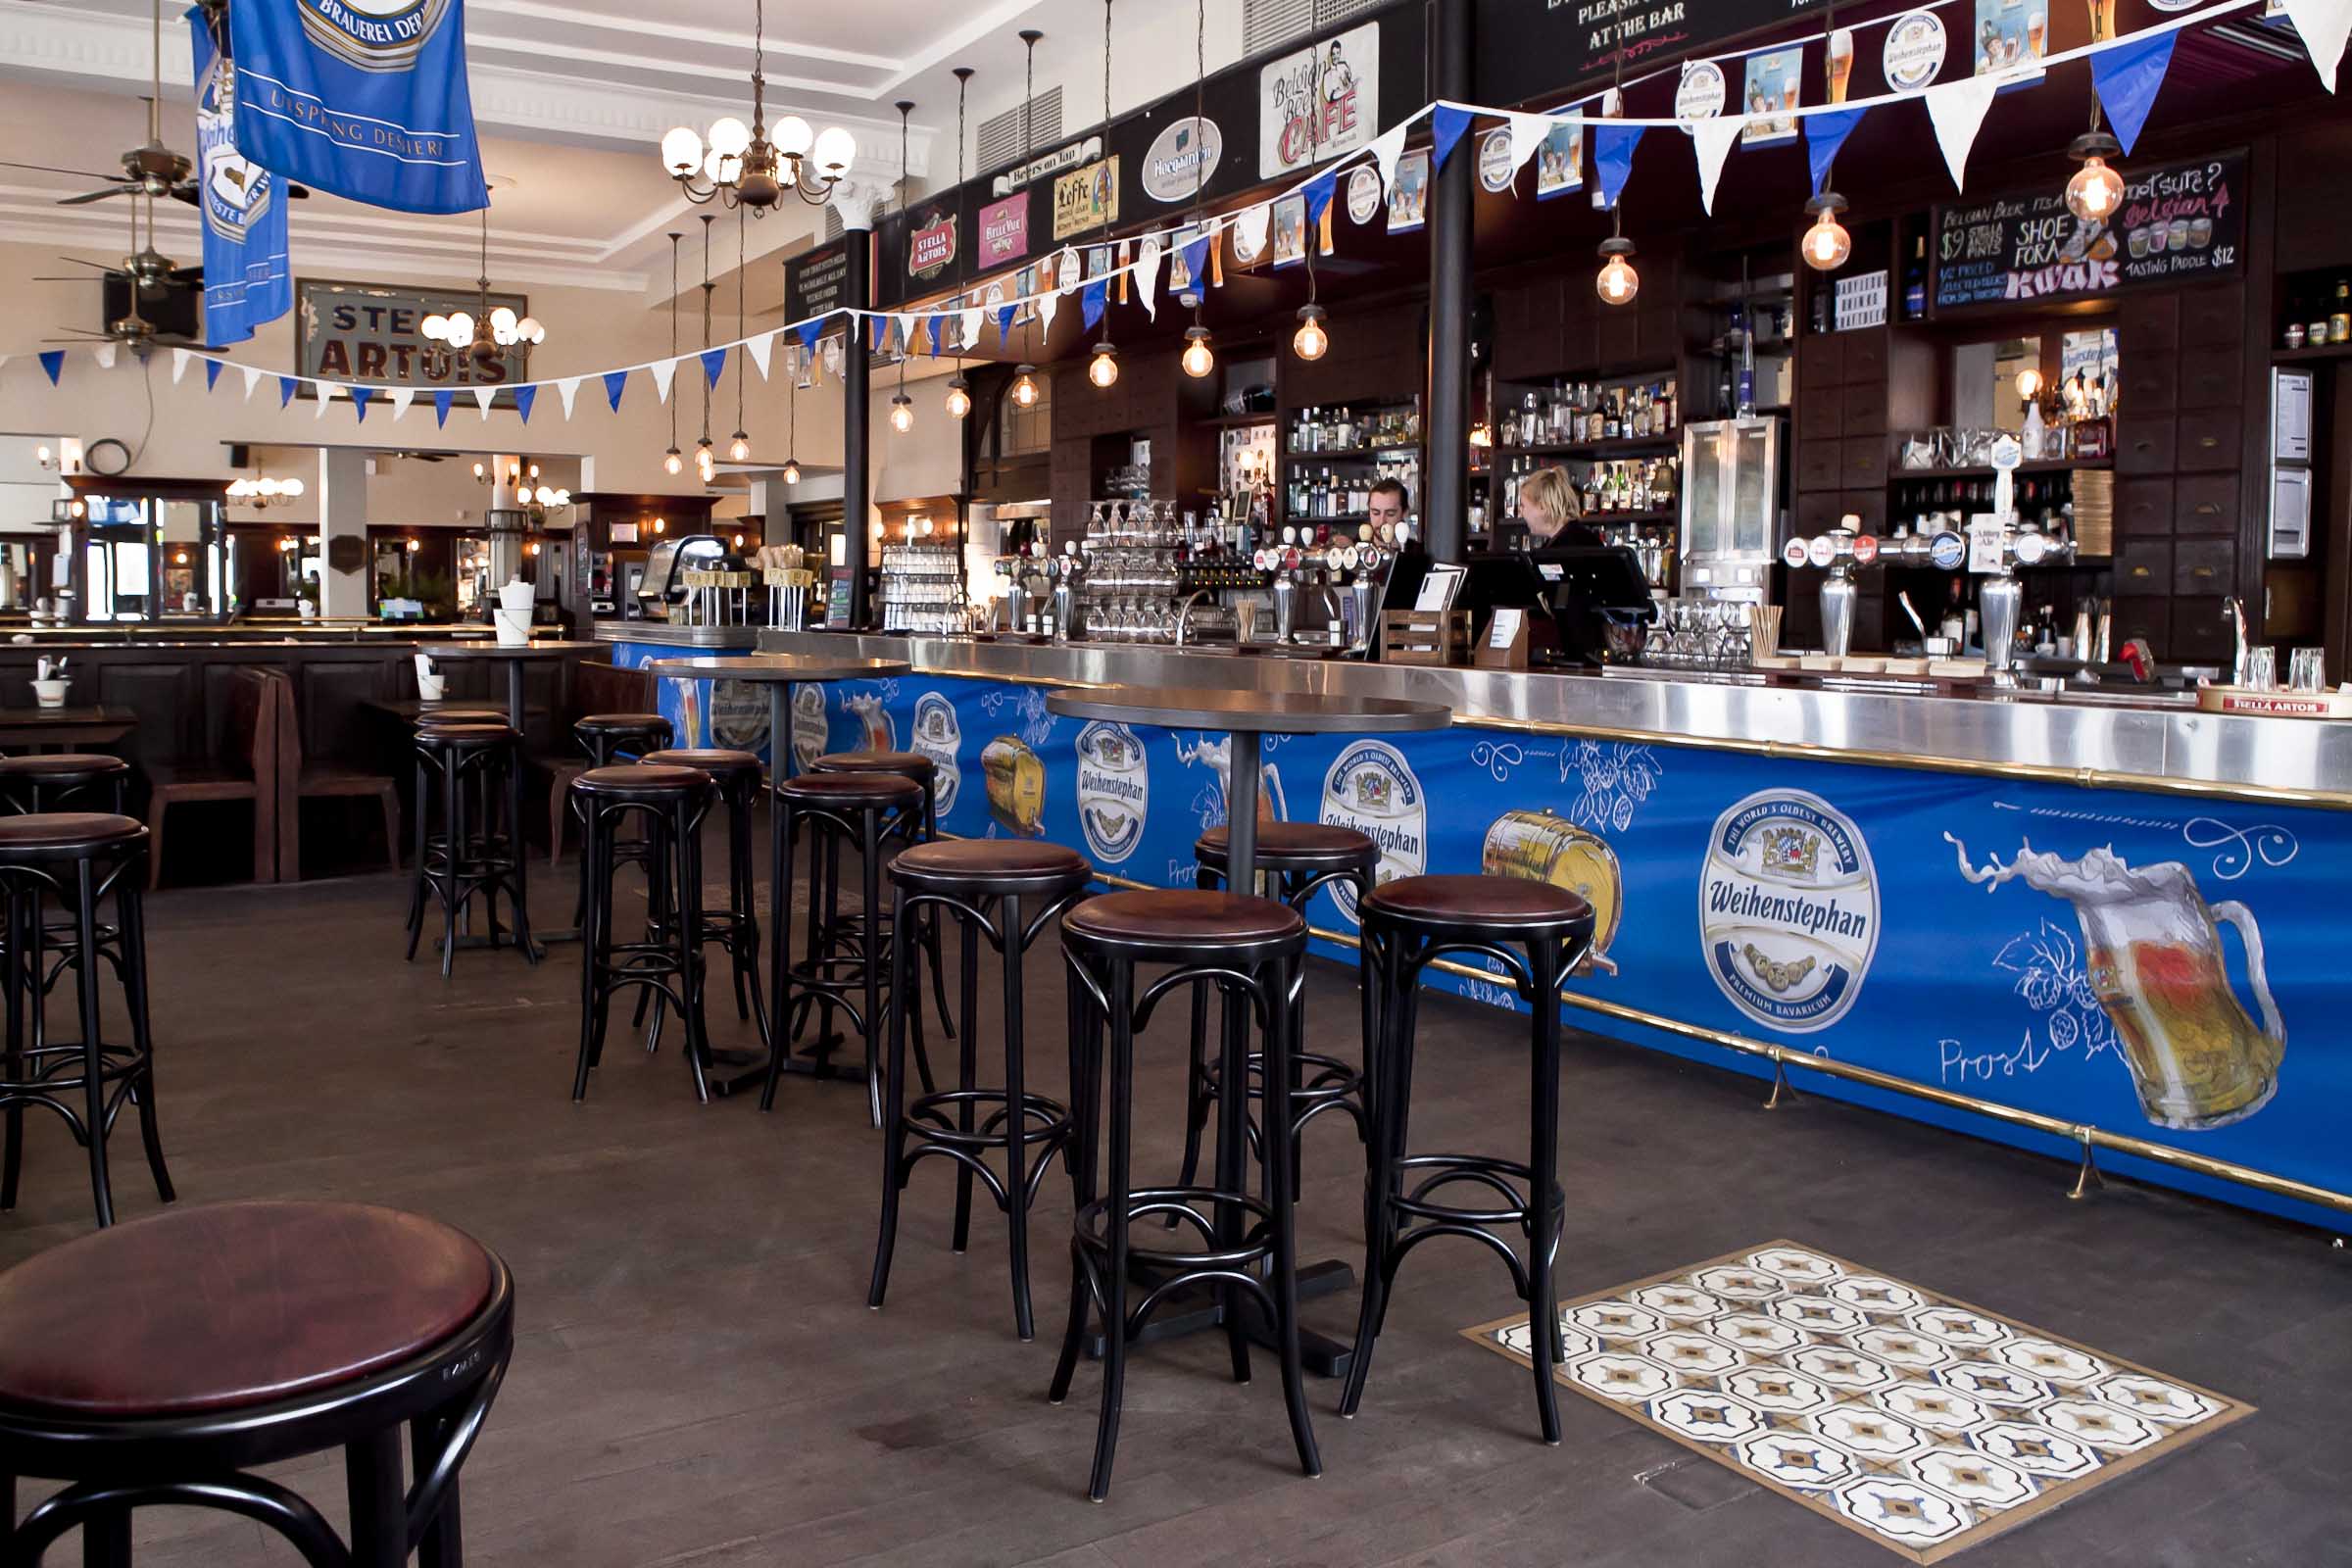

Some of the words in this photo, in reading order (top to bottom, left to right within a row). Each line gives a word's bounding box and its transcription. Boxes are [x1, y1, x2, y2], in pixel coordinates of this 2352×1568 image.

[319, 0, 392, 42] BRAUEREI
[398, 12, 423, 39] DER
[1590, 26, 1611, 49] AT
[1614, 16, 1645, 39] THE
[1649, 2, 1686, 28] BAR
[1274, 61, 1328, 109] Belgian
[1284, 91, 1318, 125] Bee
[1044, 156, 1057, 170] on
[1058, 148, 1075, 164] Tap
[1058, 176, 1089, 208] Leffe
[2125, 172, 2163, 200] not
[1944, 209, 1991, 228] BELGIAN
[1993, 201, 2026, 220] BEER
[2016, 214, 2071, 246] SHOE
[917, 231, 947, 252] STELLA
[917, 244, 948, 265] ARTOIS
[1939, 228, 1966, 262] $9
[2015, 242, 2046, 268] FOR
[2125, 258, 2168, 276] TASTING
[2171, 255, 2207, 271] PADDLE
[2212, 244, 2234, 268] $12
[318, 339, 507, 384] ARTOIS
[2233, 698, 2272, 710] STELLA
[2274, 701, 2318, 712] ARTOIS
[1082, 769, 1144, 802] Weihenstephan
[1370, 752, 1392, 766] OLDEST
[1390, 763, 1412, 800] BREWERY
[1728, 828, 1741, 847] THE
[1780, 804, 1817, 823] OLDEST
[1820, 817, 1853, 865] BREWERY
[1709, 880, 1867, 940] Weihenstephan
[1728, 972, 1773, 1013] PREMIUM
[1776, 994, 1833, 1017] BAVARICUM
[1937, 1027, 2050, 1085] Prost
